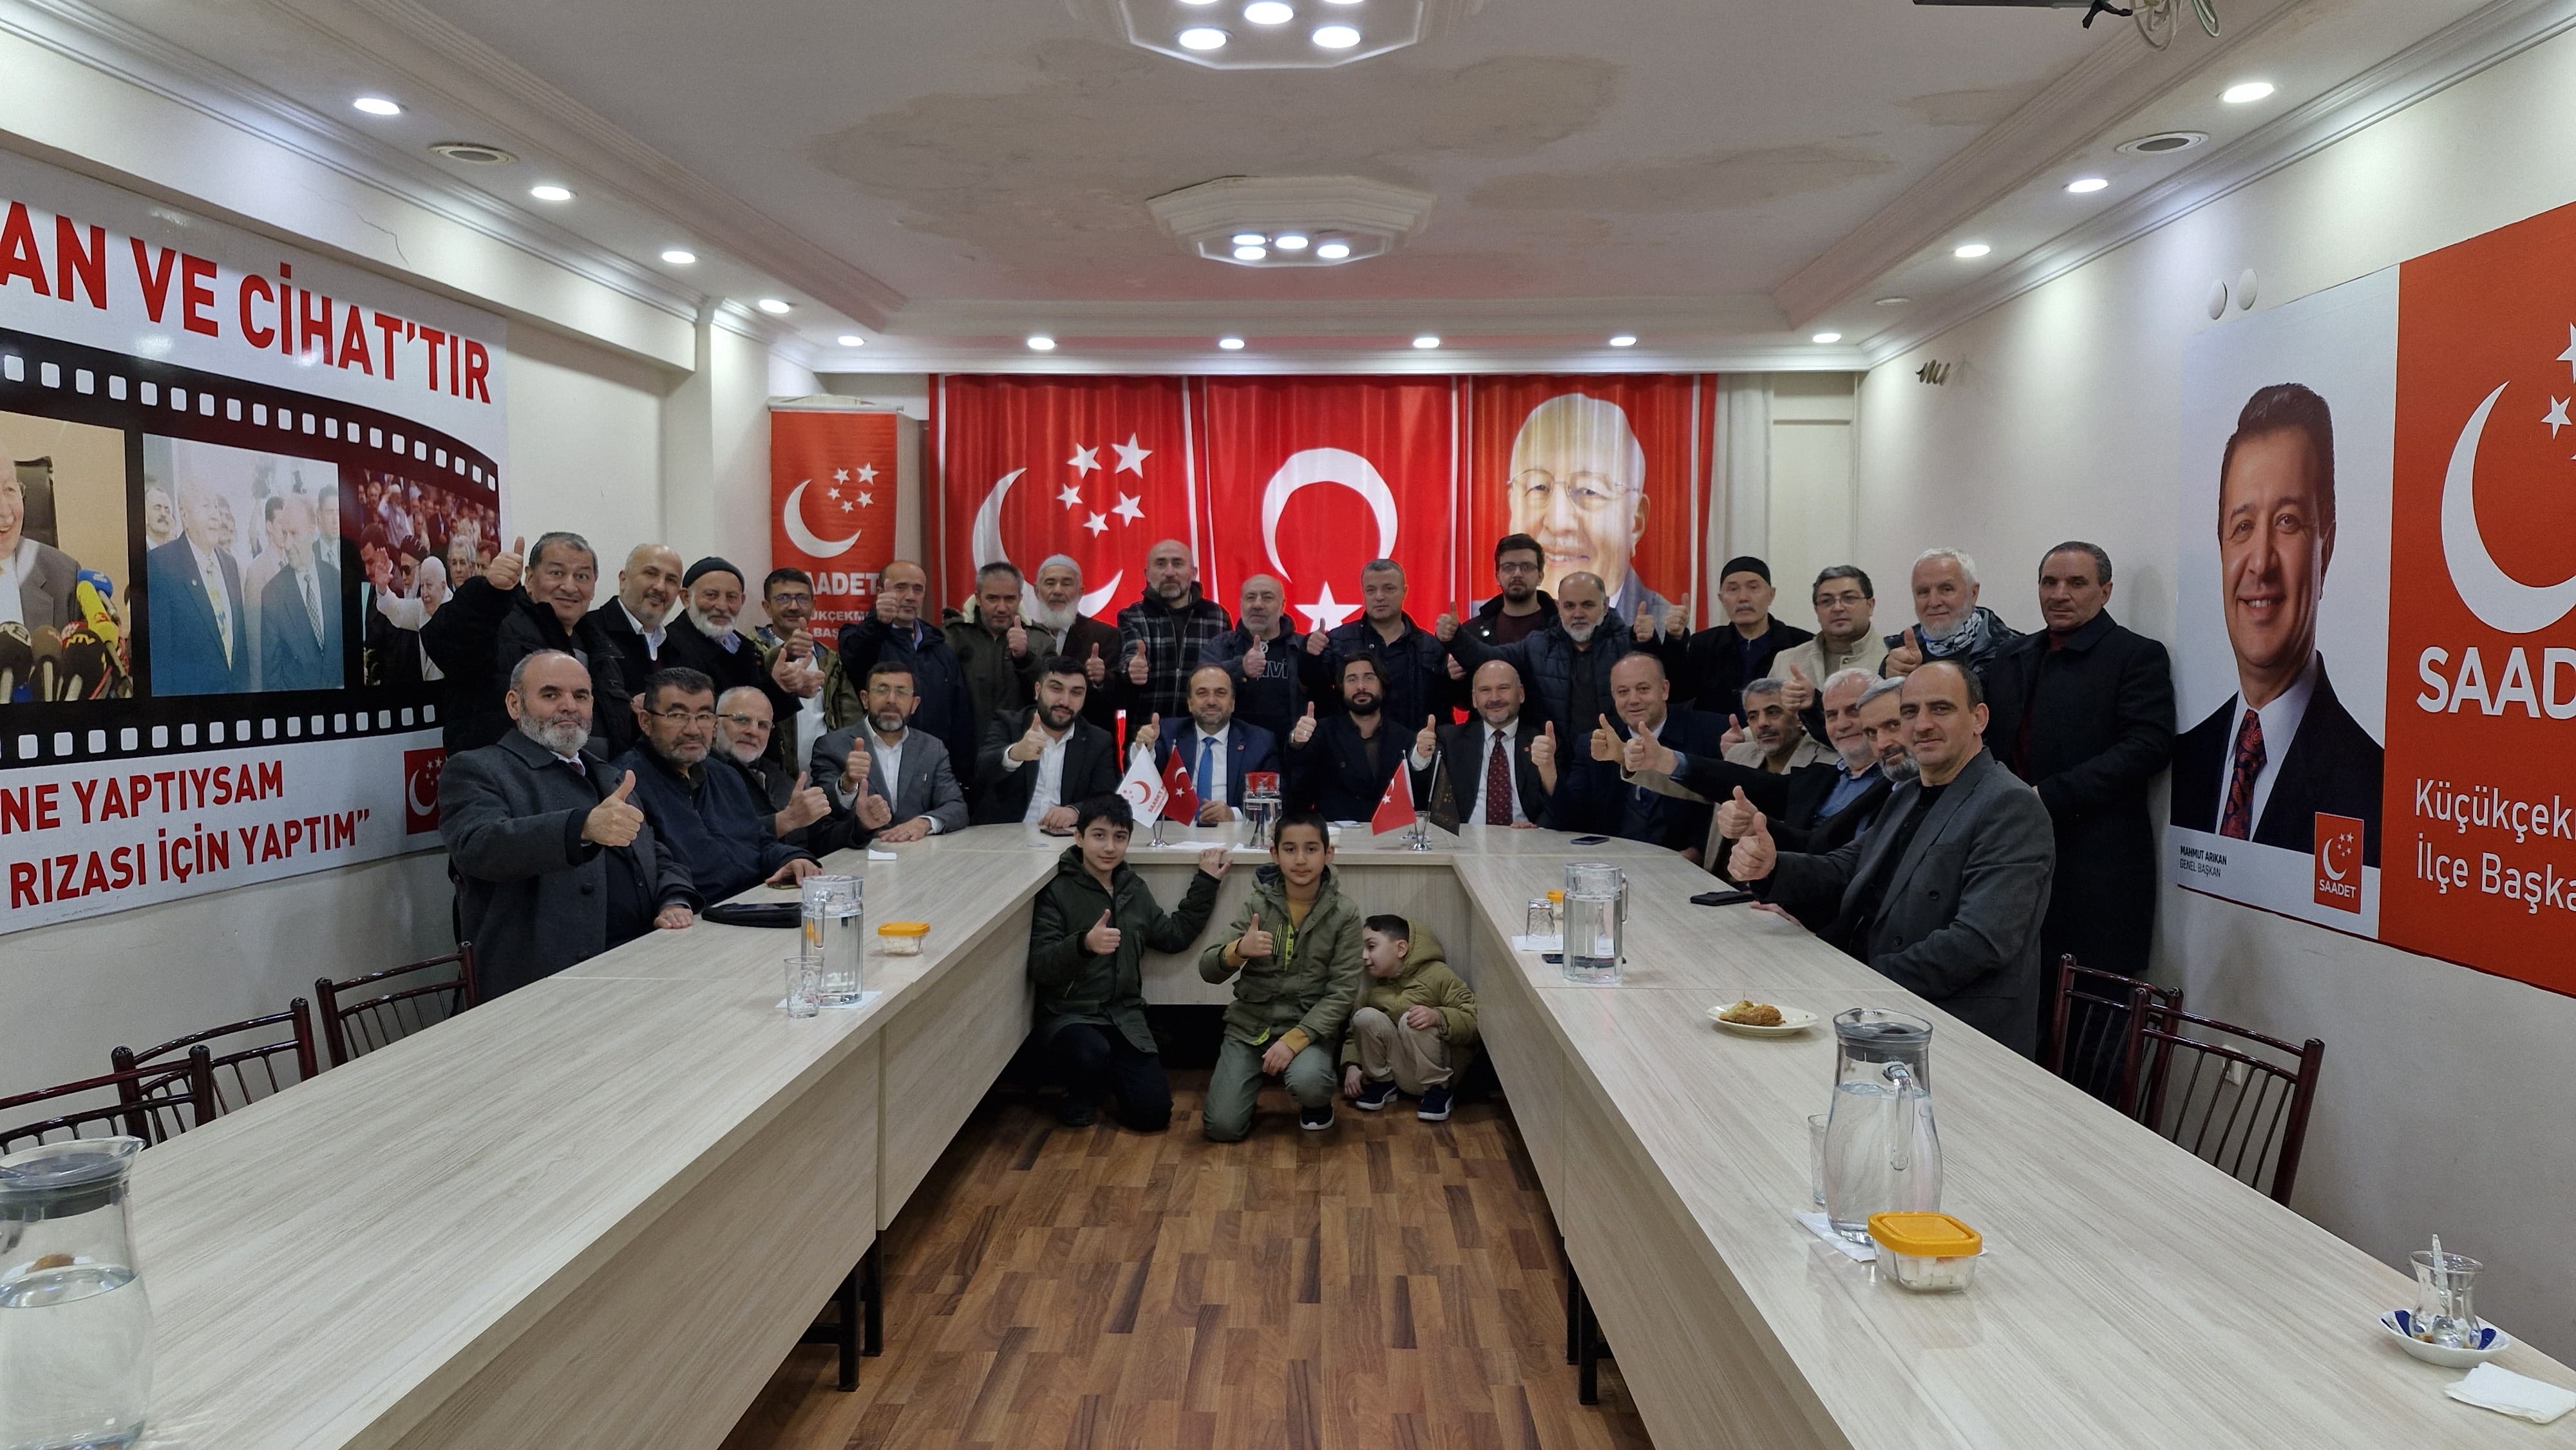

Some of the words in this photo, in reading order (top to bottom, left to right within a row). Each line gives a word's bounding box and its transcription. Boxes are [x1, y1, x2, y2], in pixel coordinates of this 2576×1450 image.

[0, 200, 107, 310] AN
[130, 236, 219, 337] VE
[805, 571, 880, 596] ADET
[2416, 646, 2576, 720] SAAD
[1, 783, 61, 834] NE
[72, 760, 283, 823] YAPTIYSAM
[2416, 778, 2576, 843] Küçükçek
[10, 837, 146, 908] RIZASI
[158, 823, 229, 883] İÇİN
[2179, 858, 2196, 872] GENEL
[2198, 863, 2221, 878] BAŞKAN
[2180, 845, 2204, 860] MAHMUT
[2205, 851, 2227, 865] ARIKAN
[2418, 833, 2468, 894] İlçe
[2319, 879, 2356, 898] SAADET
